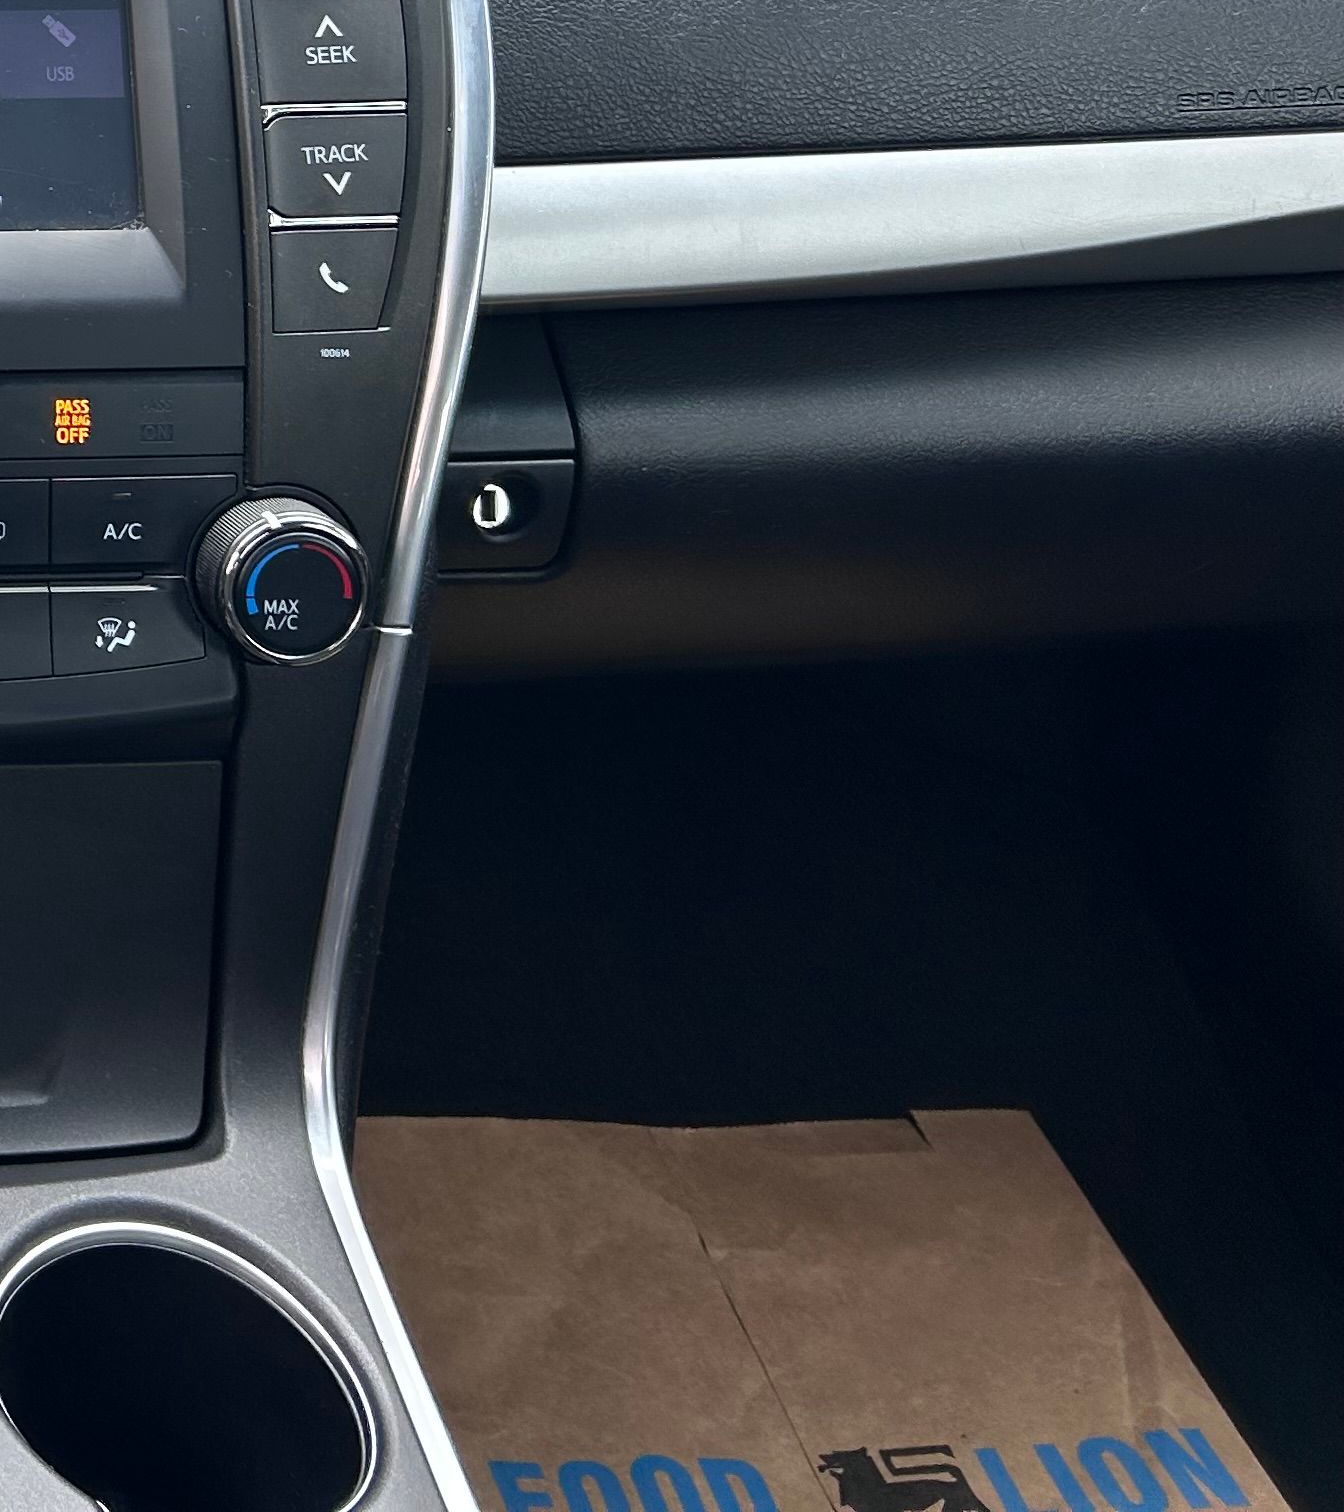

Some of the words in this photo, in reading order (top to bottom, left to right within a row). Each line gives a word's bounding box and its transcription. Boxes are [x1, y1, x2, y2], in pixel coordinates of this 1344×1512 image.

[304, 45, 357, 65] SEEK
[45, 65, 75, 83] USB
[300, 143, 369, 165] TRACK
[54, 399, 91, 415] PASS
[54, 413, 71, 427] AIR
[71, 413, 91, 427] BAG
[55, 427, 90, 444] OFF
[103, 523, 143, 540] A/C
[263, 598, 300, 615] MAX
[264, 614, 299, 631] A/C
[972, 1427, 1252, 1512] LION
